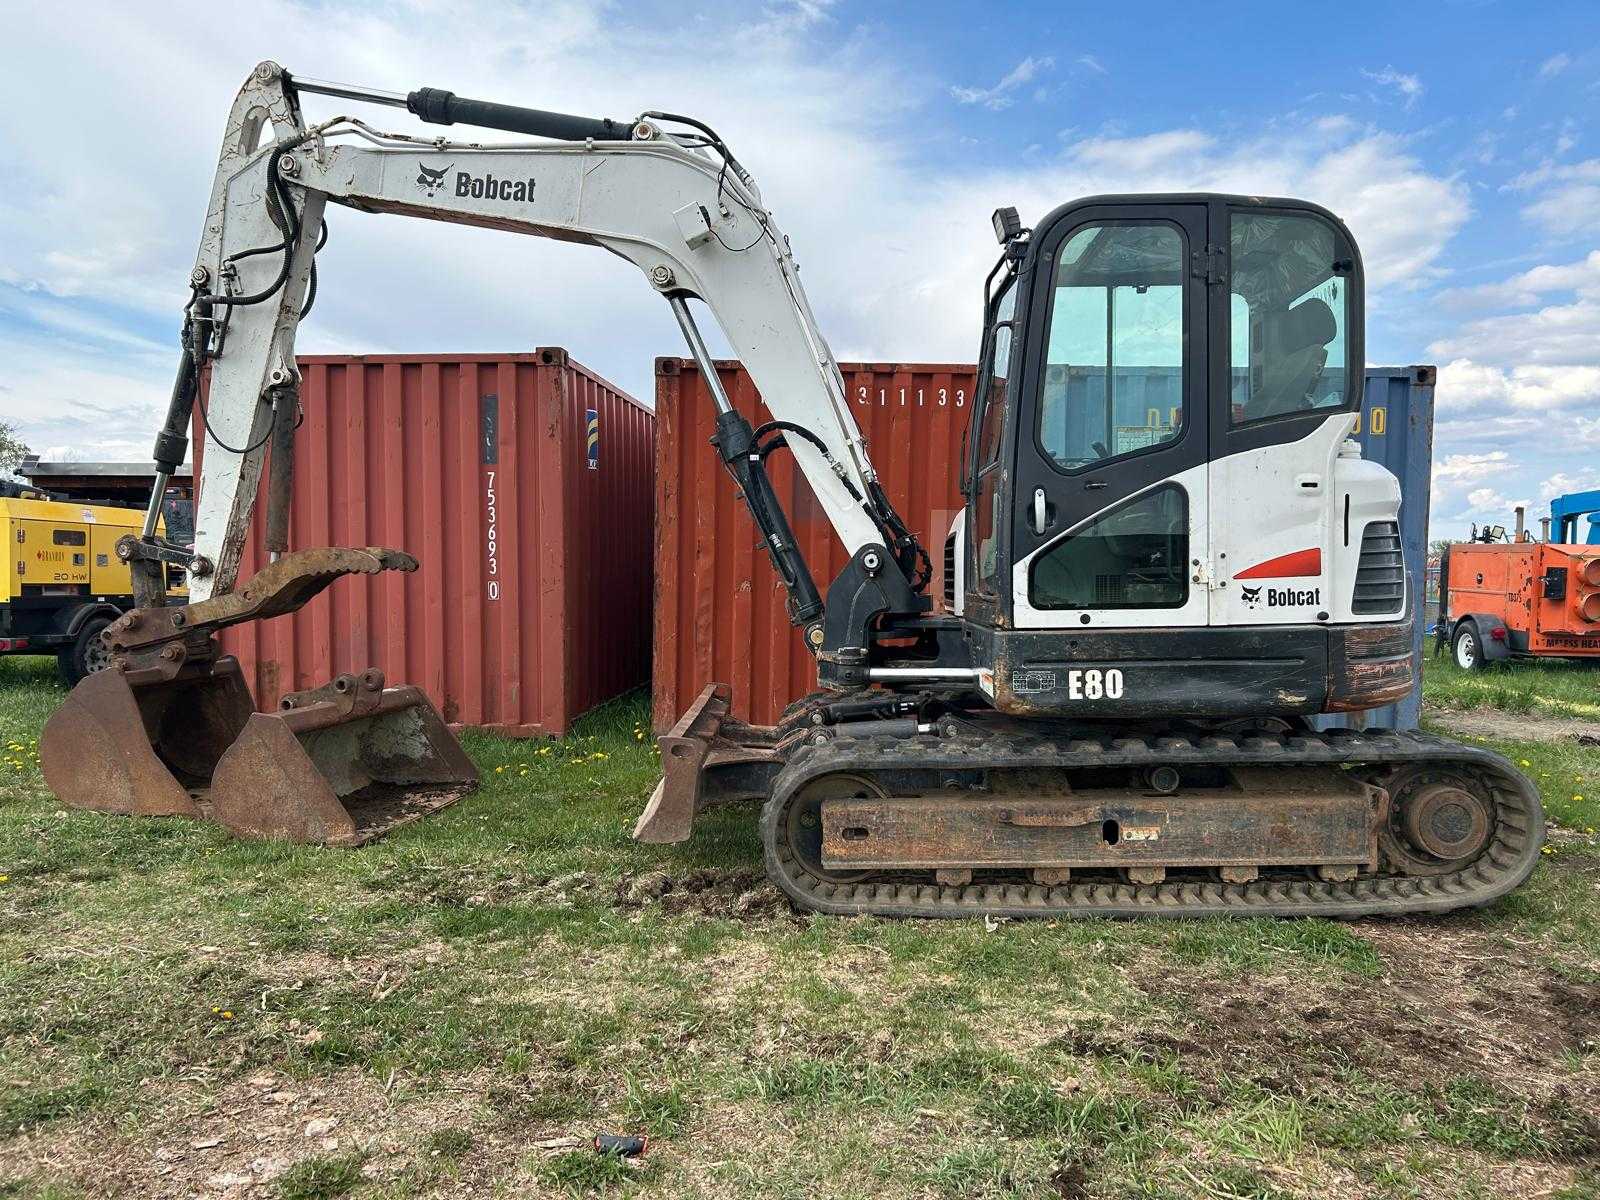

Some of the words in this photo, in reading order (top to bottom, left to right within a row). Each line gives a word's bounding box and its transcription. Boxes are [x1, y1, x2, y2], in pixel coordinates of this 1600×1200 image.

[455, 172, 536, 202] Bobcat
[1268, 588, 1320, 606] Bobcat
[1068, 669, 1123, 699] E80
